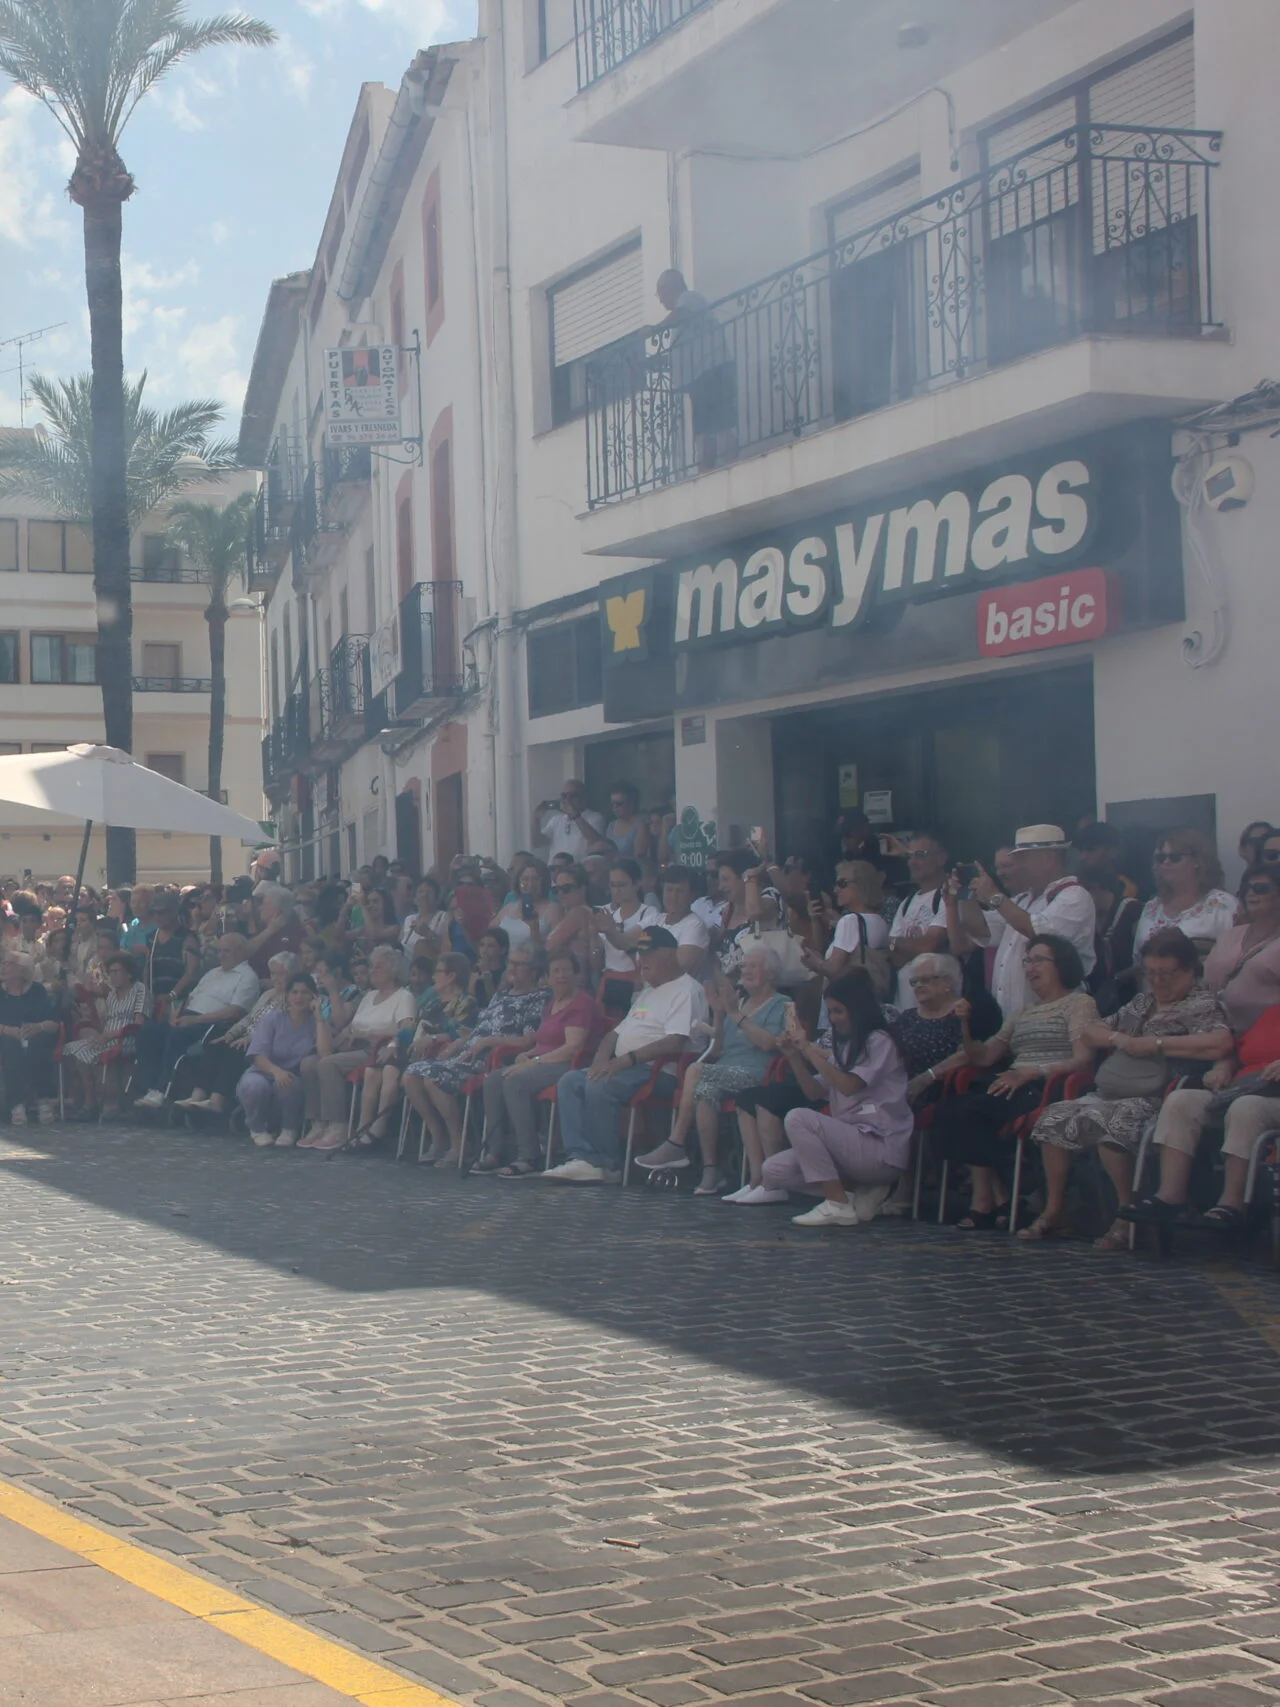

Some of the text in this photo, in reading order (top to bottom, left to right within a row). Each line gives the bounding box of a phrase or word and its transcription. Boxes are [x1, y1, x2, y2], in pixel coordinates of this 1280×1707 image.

[328, 351, 341, 418] PUERTAS
[674, 460, 1090, 643] masymas
[985, 586, 1095, 645] basic
